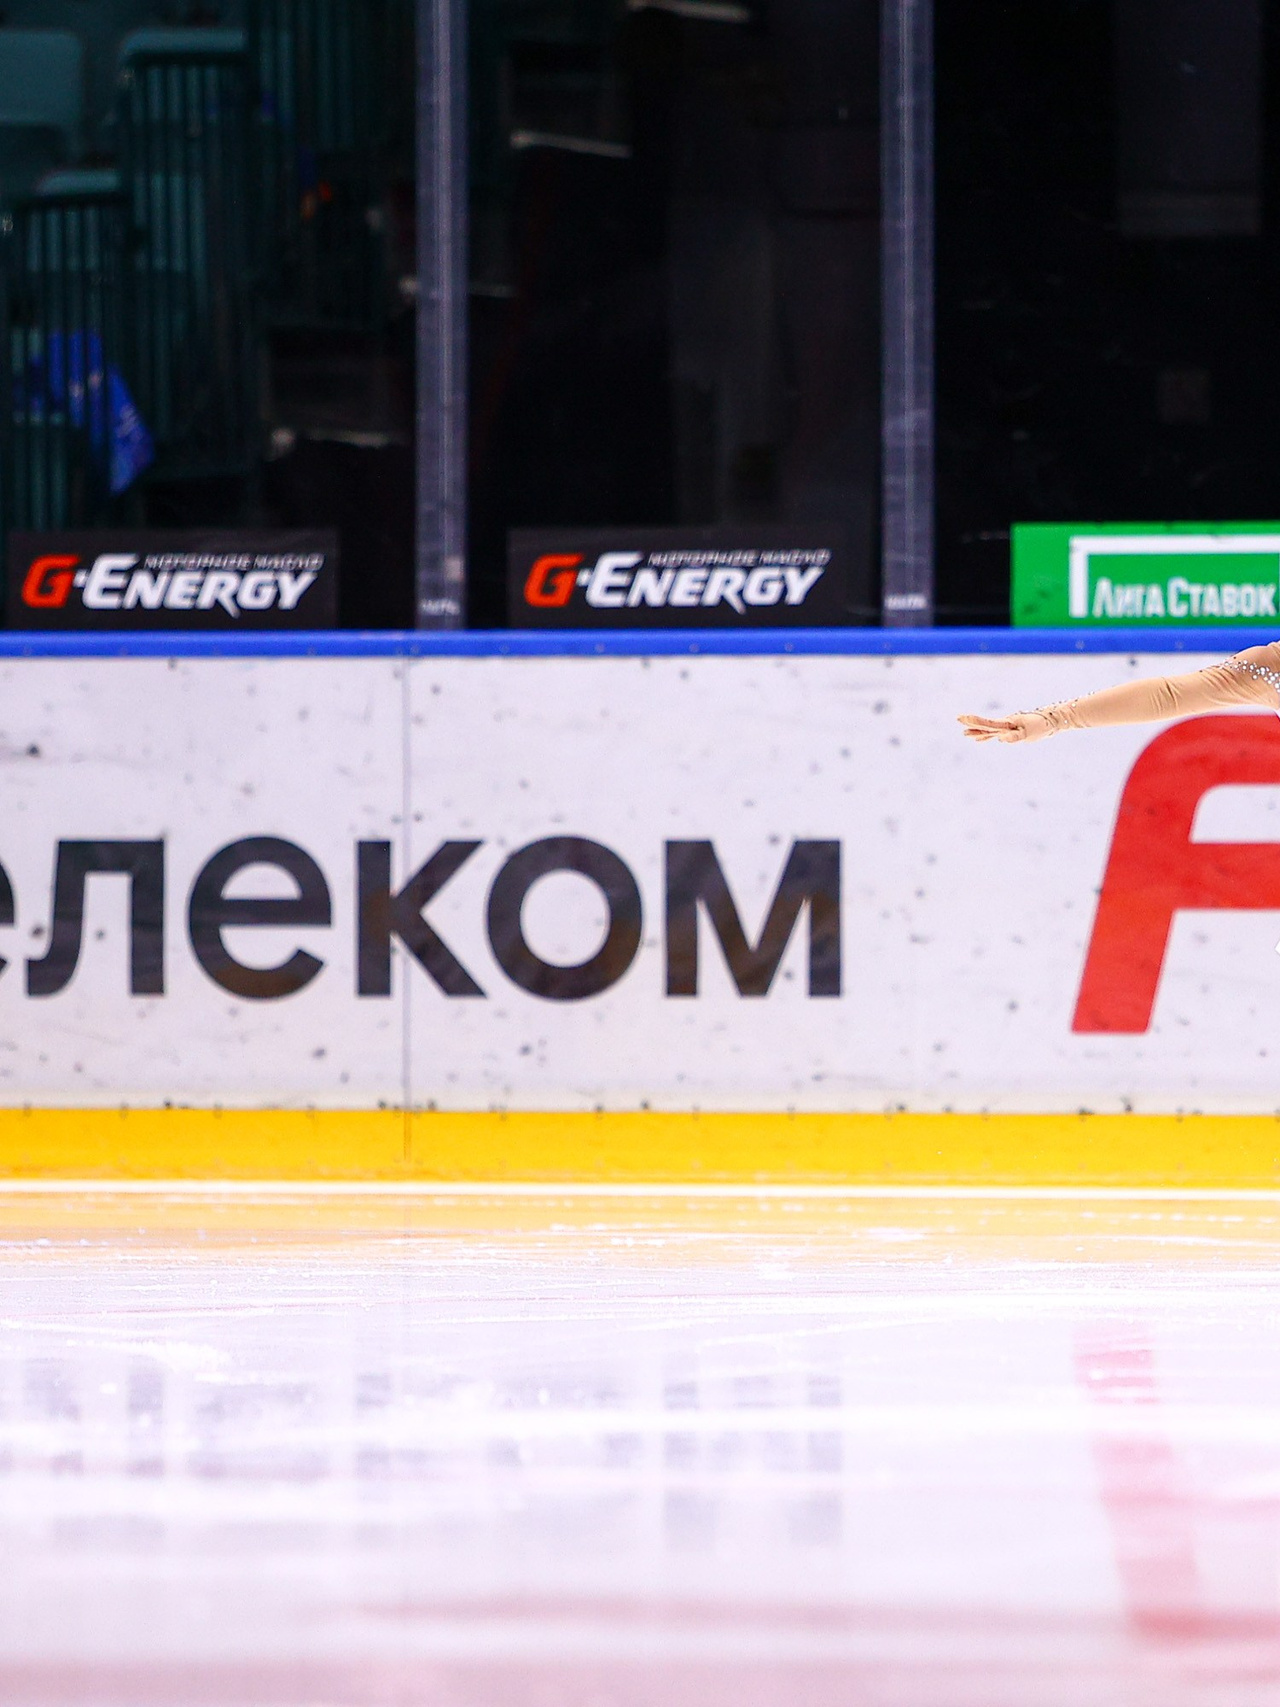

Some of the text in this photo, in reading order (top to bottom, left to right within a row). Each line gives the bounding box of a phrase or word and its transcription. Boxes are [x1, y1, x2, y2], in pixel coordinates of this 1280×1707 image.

[1092, 576, 1277, 618] ЛИГА СТАВОК
[0, 835, 843, 1002] леком
